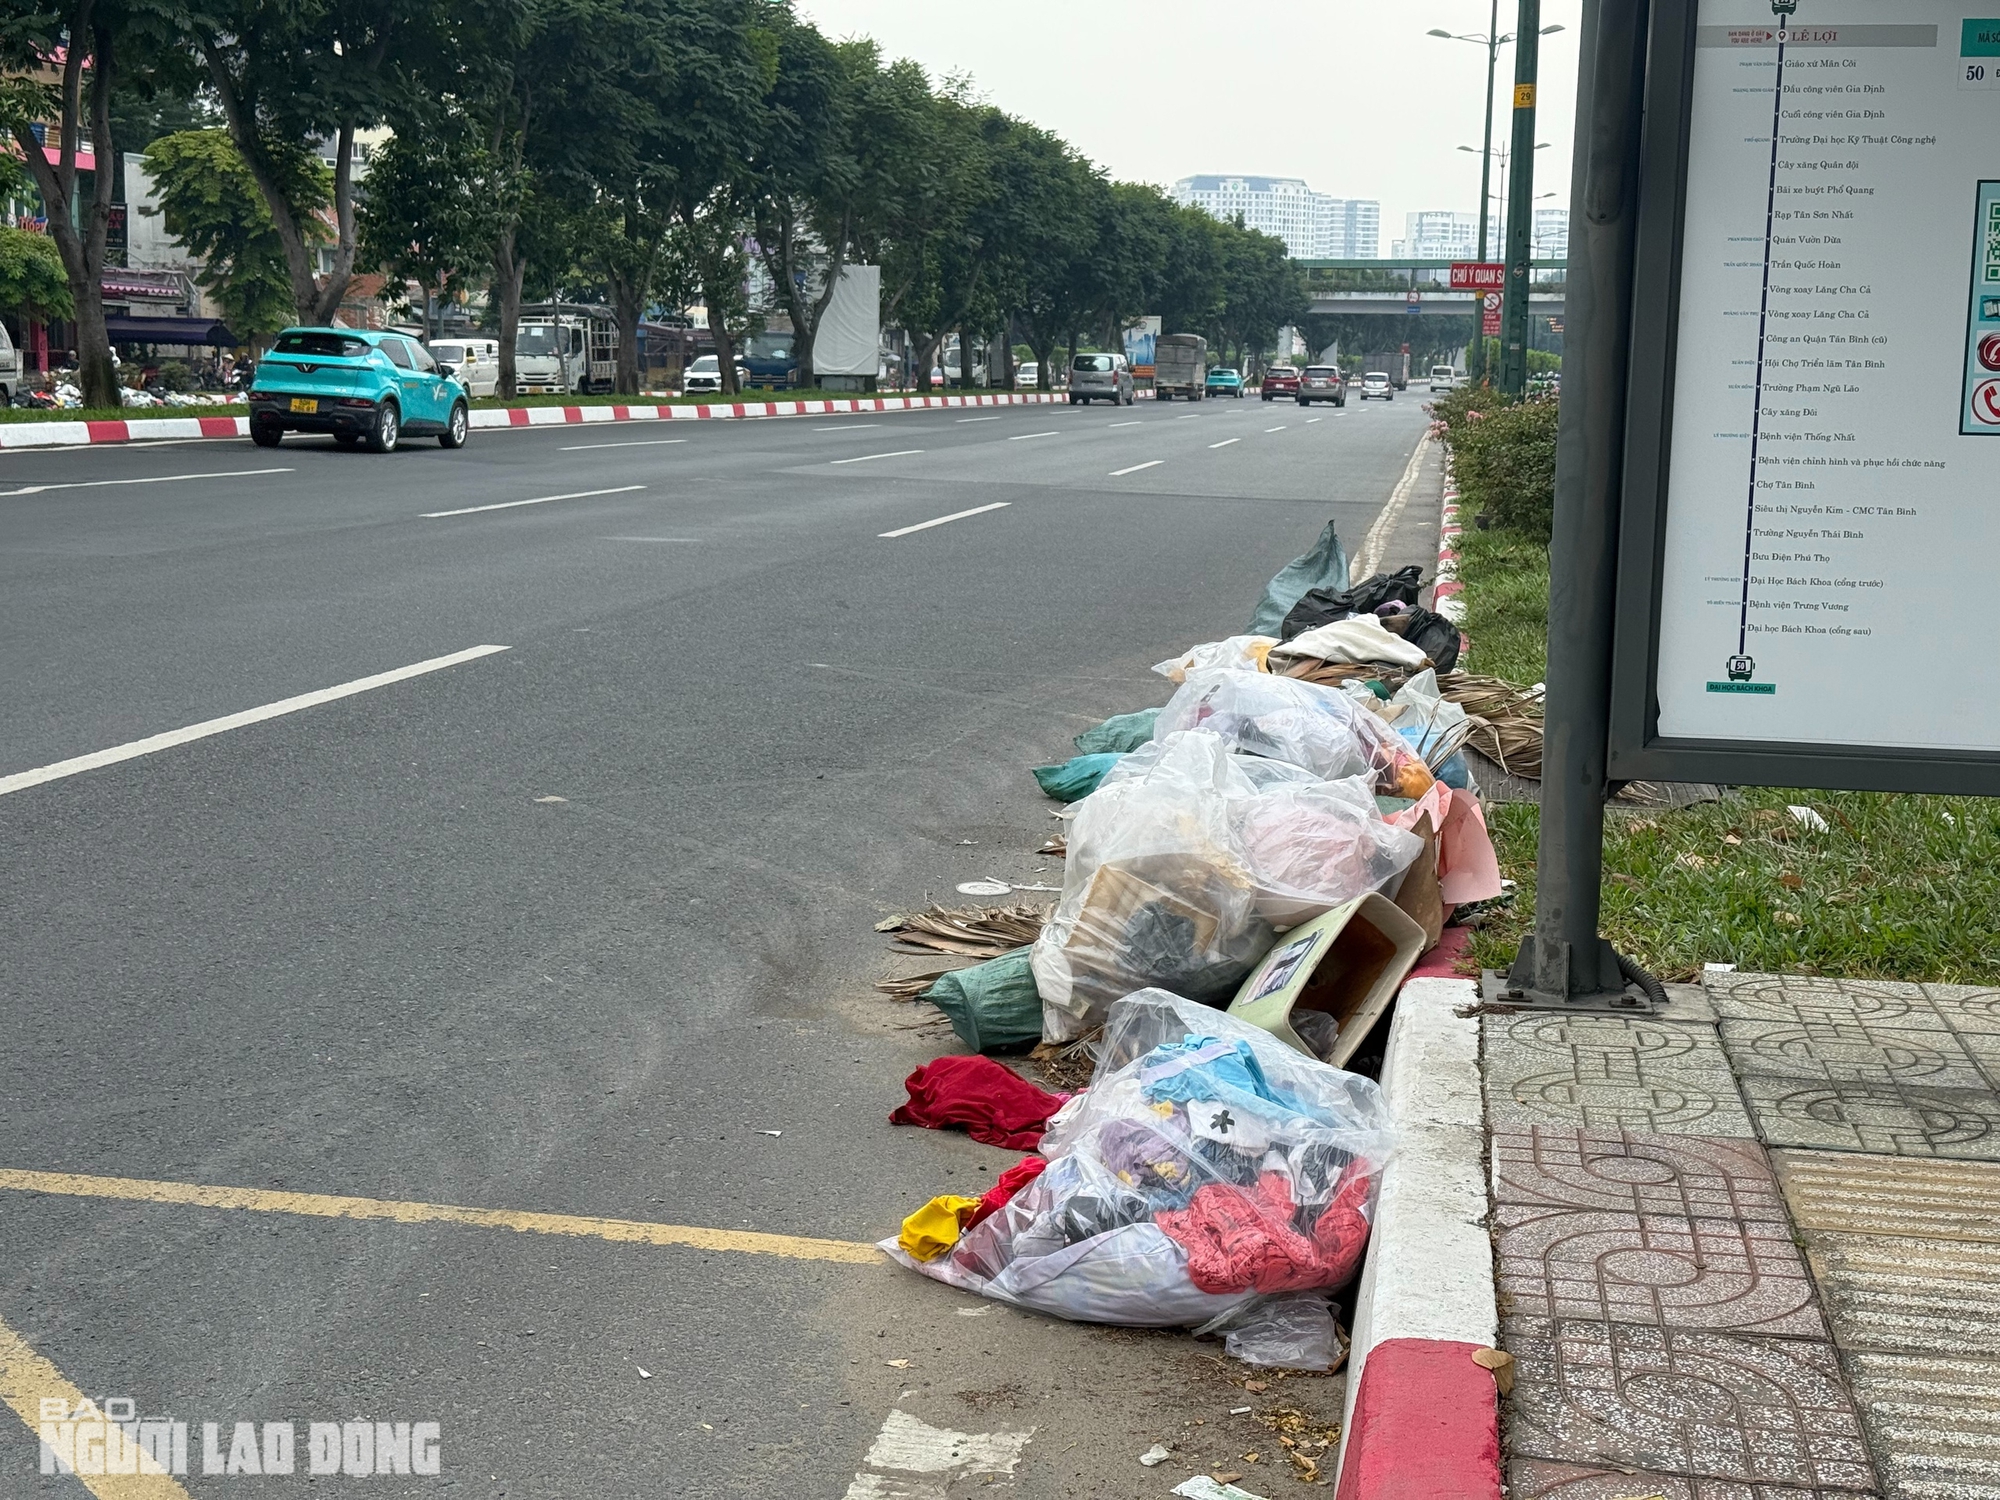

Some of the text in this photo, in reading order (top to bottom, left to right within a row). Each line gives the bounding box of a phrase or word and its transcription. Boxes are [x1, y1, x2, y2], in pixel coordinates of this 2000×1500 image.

[1792, 29, 1838, 44] LÊ LỢI
[1785, 60, 1805, 68] Giáo
[1820, 60, 1840, 68] Mân
[1842, 59, 1856, 68] Côi
[1966, 65, 1985, 81] 50
[1803, 86, 1823, 94] công
[1825, 85, 1843, 93] viên
[1846, 85, 1861, 93] Gia
[1864, 85, 1885, 94] Định
[1520, 91, 1531, 101] 29
[1803, 111, 1823, 120] công
[1826, 110, 1843, 118] viên
[1846, 110, 1861, 118] Gia
[1864, 110, 1885, 120] Định
[1780, 135, 1811, 145] Trường
[1813, 136, 1828, 145] Đại
[1831, 136, 1845, 145] học
[1862, 135, 1888, 145] Thuật
[1891, 135, 1913, 145] Công
[1915, 135, 1936, 145] nghệ
[1778, 160, 1794, 170] Cây
[1820, 161, 1843, 170] Quân
[1846, 161, 1858, 170] đội
[1805, 186, 1825, 195] buýt
[1846, 186, 1875, 196] Quang
[1774, 211, 1792, 220] Rạp
[1794, 211, 1811, 219] Tân
[1813, 211, 1829, 219] Sơn
[1773, 235, 1796, 245] Quán
[1799, 235, 1821, 244] Vườn
[1794, 260, 1816, 270] Quốc
[1452, 265, 1468, 283] CHÚ
[1469, 265, 1475, 283] Ý
[1475, 269, 1496, 284] QUAN
[1769, 285, 1792, 295] Vòng
[1840, 286, 1857, 294] Cha
[1768, 310, 1790, 319] Vòng
[1791, 312, 1812, 320] xoay
[1838, 310, 1855, 318] Cha
[1766, 334, 1788, 344] Công
[1803, 335, 1827, 344] Quận
[1829, 335, 1846, 343] Tân
[1849, 335, 1869, 343] Bình
[1765, 359, 1779, 369] Hội
[1782, 359, 1799, 369] Chợ
[1845, 360, 1862, 368] Tân
[1865, 360, 1885, 368] Bình
[1763, 383, 1794, 393] Trường
[1796, 384, 1821, 393] Phạm
[1761, 408, 1778, 417] Cây
[1760, 432, 1782, 442] Bệnh
[1784, 433, 1802, 442] viện
[1758, 456, 1780, 466] Bệnh
[1783, 457, 1800, 465] viện
[1863, 458, 1884, 468] phục
[1756, 480, 1815, 490] Chợ Tân Bình
[1776, 505, 1787, 514] thị
[1826, 506, 1843, 514] Kim
[1852, 507, 1874, 515] CMC
[1877, 507, 1893, 515] Tân
[1753, 529, 1784, 538] Trường
[1821, 530, 1840, 538] Thái
[1772, 553, 1792, 562] Điện
[1813, 554, 1830, 563] Thọ
[1750, 576, 1765, 586] Đại
[1768, 577, 1784, 586] Học
[1786, 577, 1807, 585] Bách
[1810, 578, 1832, 586] Khoa
[1749, 600, 1771, 609] Bệnh
[1773, 601, 1791, 610] viện
[1793, 602, 1820, 611] Trưng
[1821, 602, 1849, 612] Vương
[1747, 624, 1762, 633] Đại
[1765, 624, 1779, 634] học
[1782, 625, 1802, 633] Bách
[1853, 627, 1872, 636] sau)
[1737, 662, 1745, 670] 50
